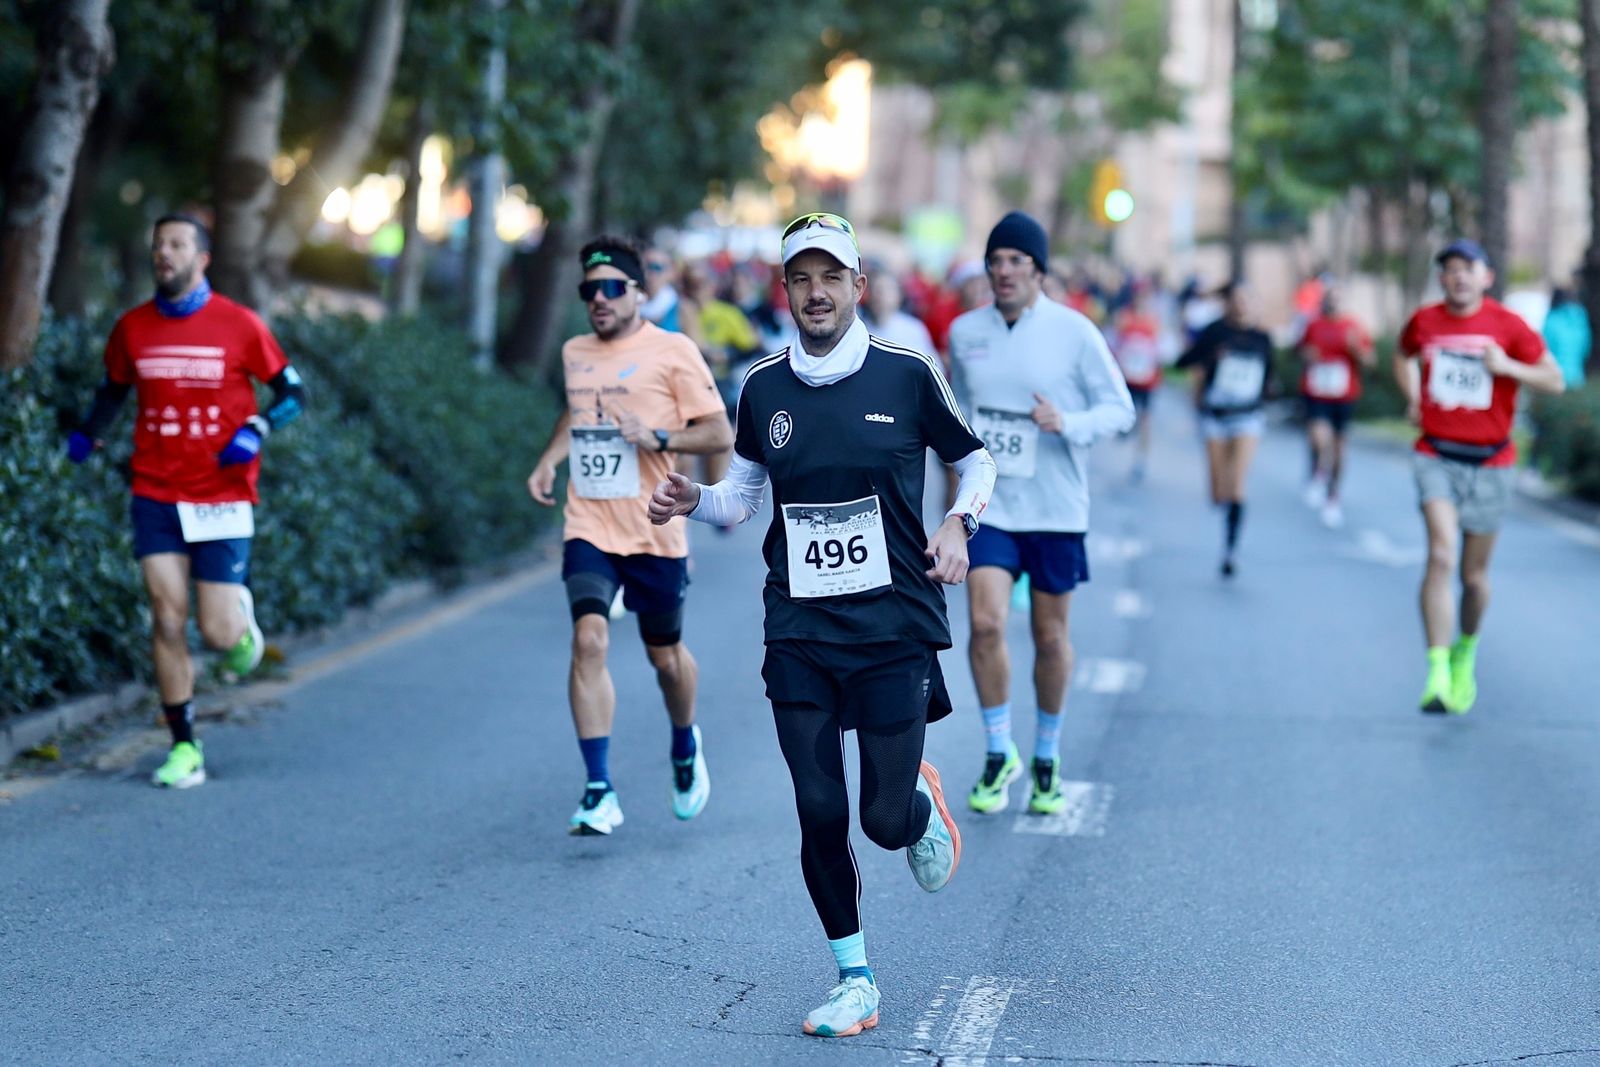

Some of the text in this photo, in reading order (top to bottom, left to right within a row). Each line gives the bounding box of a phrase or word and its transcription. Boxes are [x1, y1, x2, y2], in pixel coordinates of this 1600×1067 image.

[865, 413, 895, 424] adidas
[581, 454, 622, 477] 597
[805, 535, 868, 569] 496
